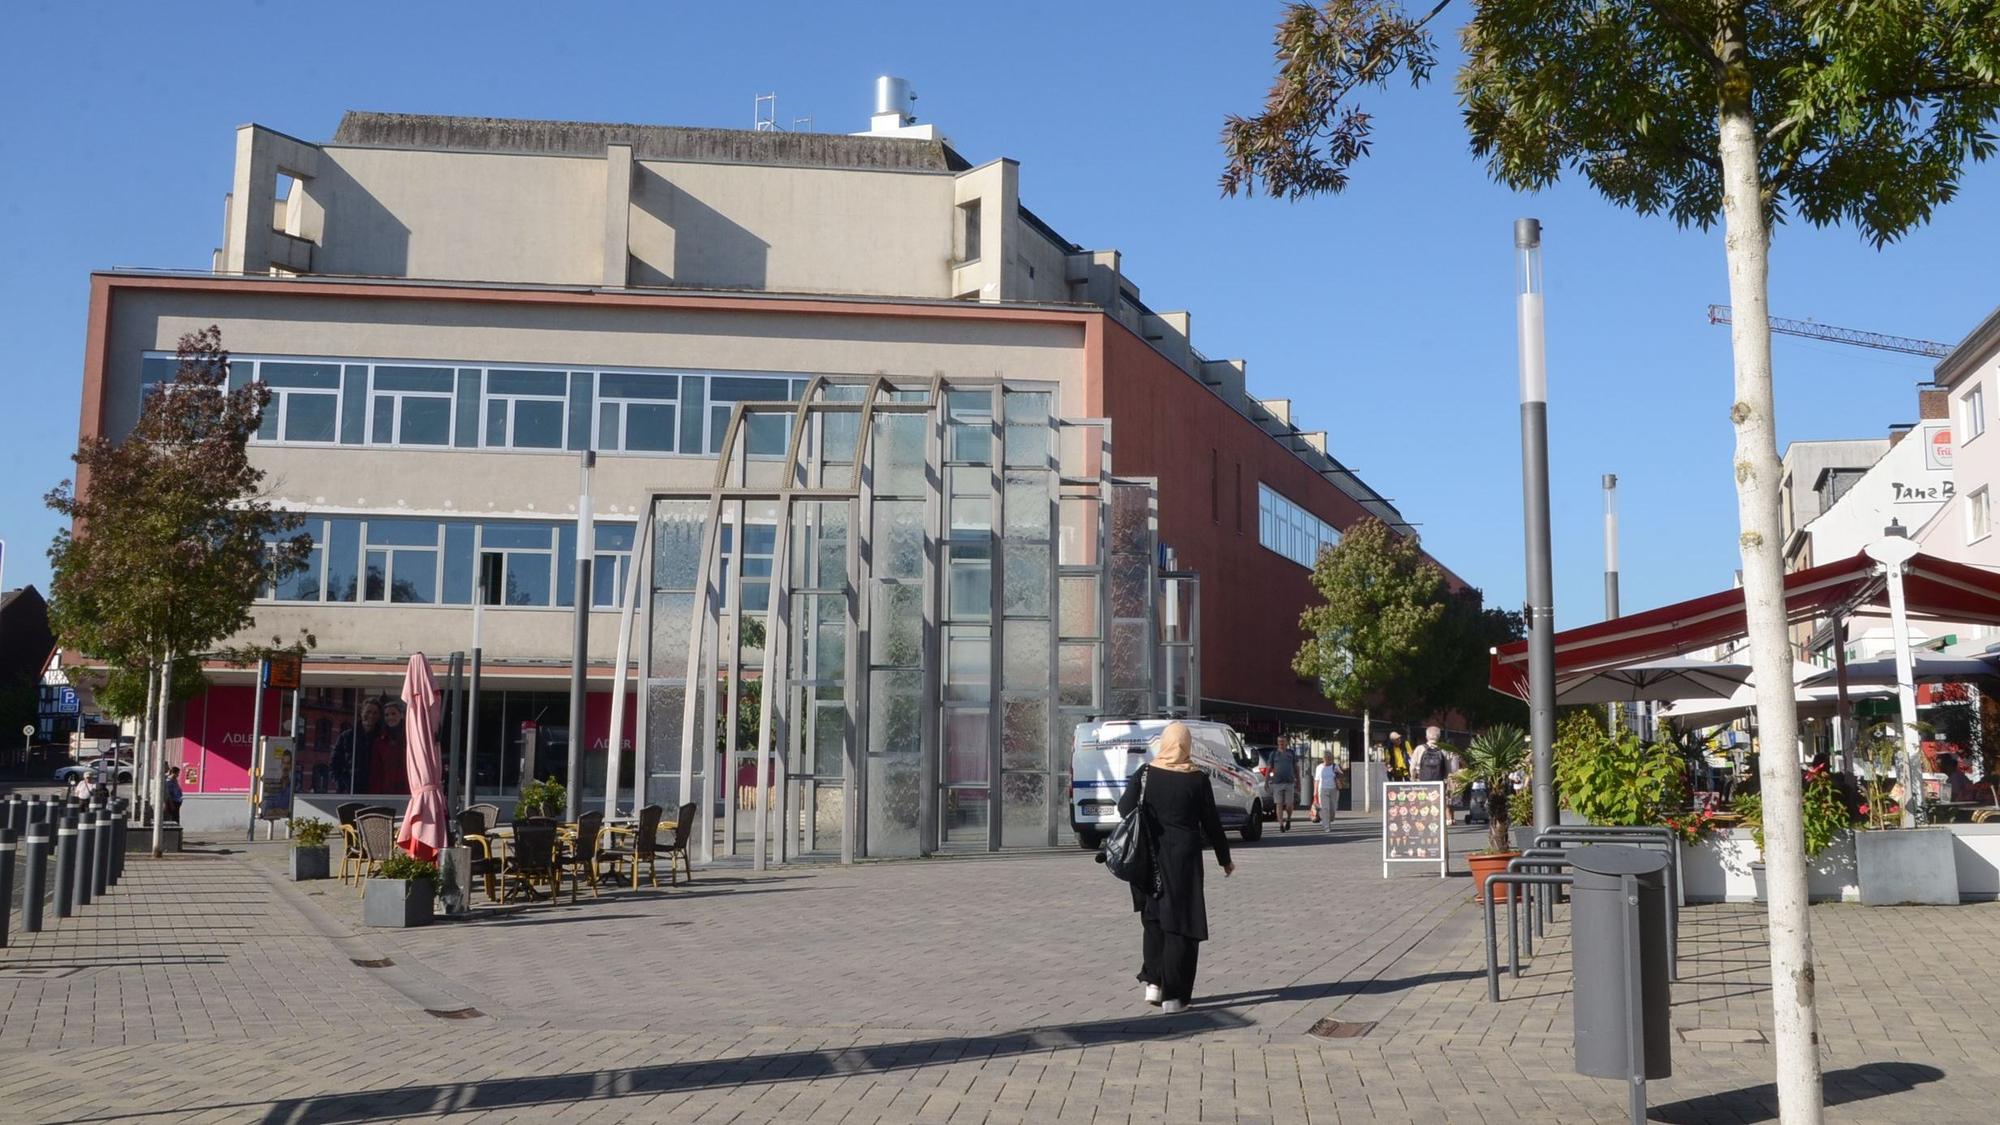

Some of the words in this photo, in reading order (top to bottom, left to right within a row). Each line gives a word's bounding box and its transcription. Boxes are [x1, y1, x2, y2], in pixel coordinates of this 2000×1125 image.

[1936, 446, 1952, 455] frü
[65, 691, 75, 703] P
[223, 731, 254, 744] ADLE
